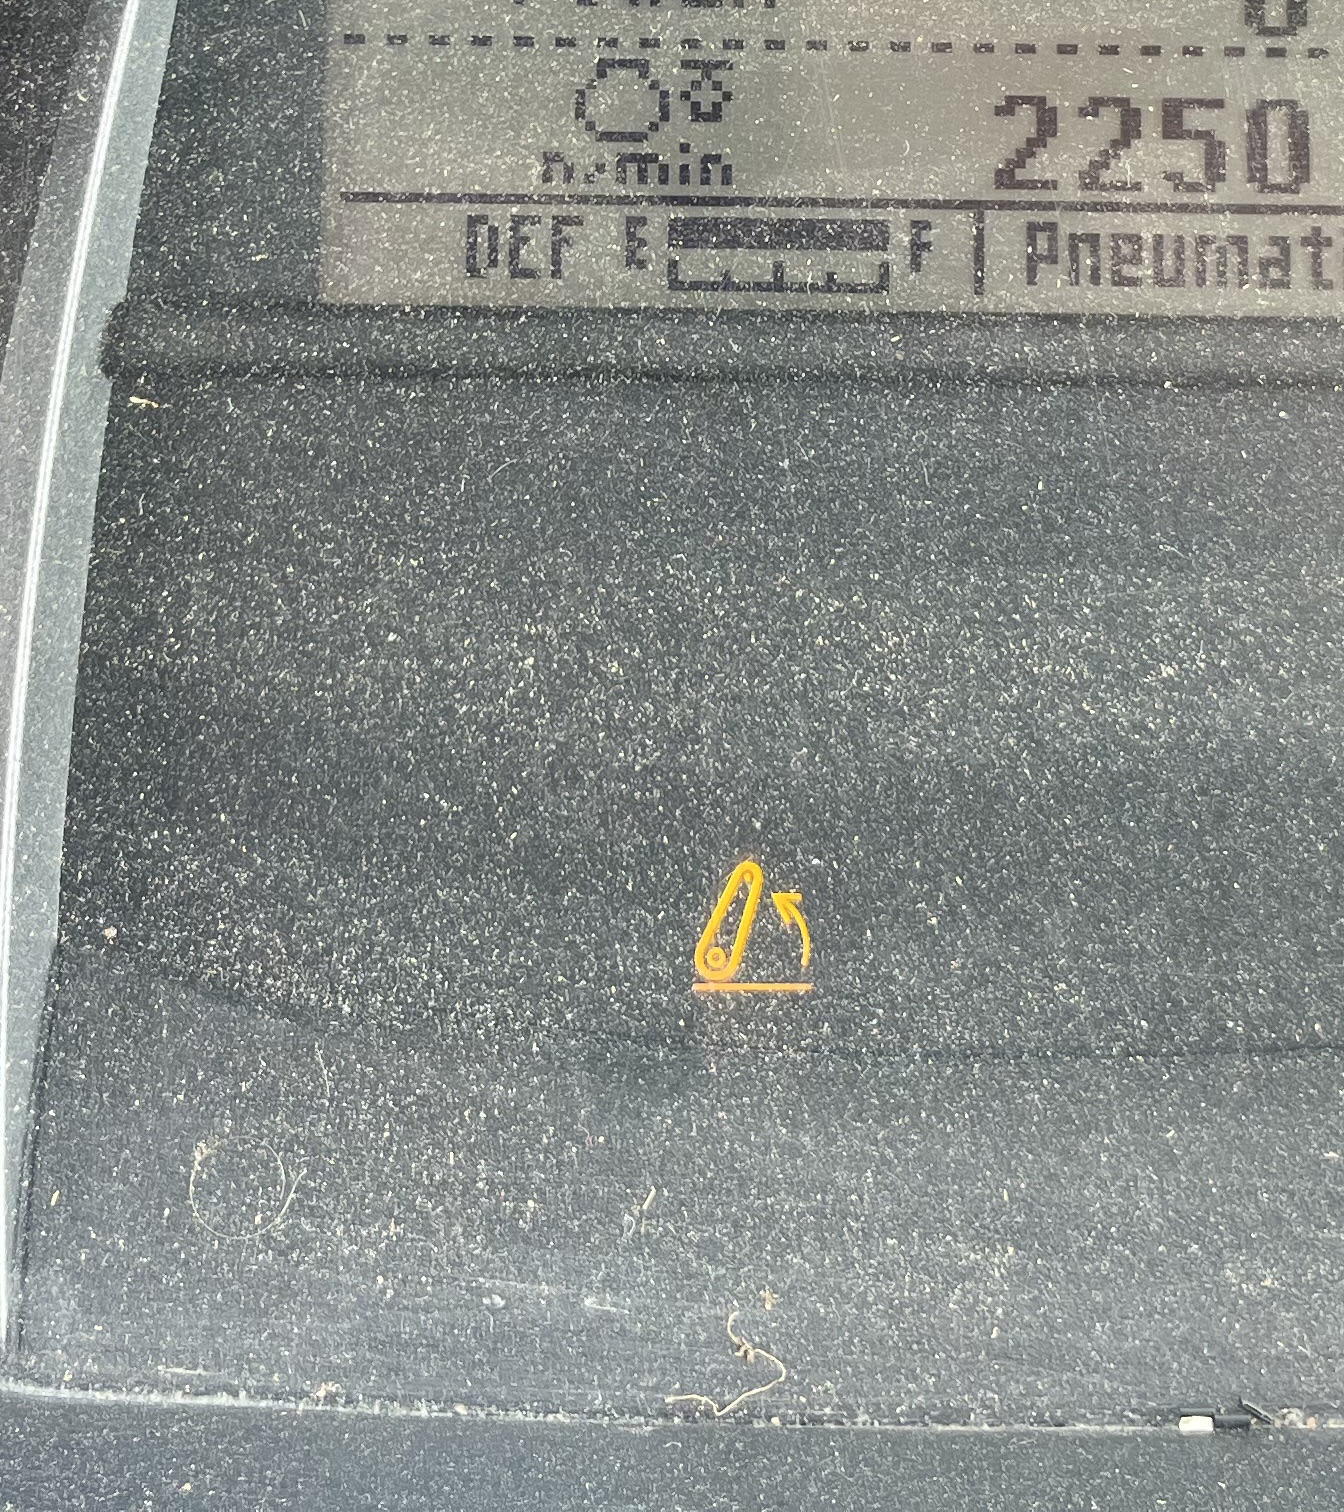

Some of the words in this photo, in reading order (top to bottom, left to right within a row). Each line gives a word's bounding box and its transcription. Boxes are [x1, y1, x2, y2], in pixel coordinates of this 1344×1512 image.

[993, 95, 1311, 194] 2250
[466, 215, 582, 280] DEF
[625, 215, 648, 269] E
[910, 220, 933, 273] F
